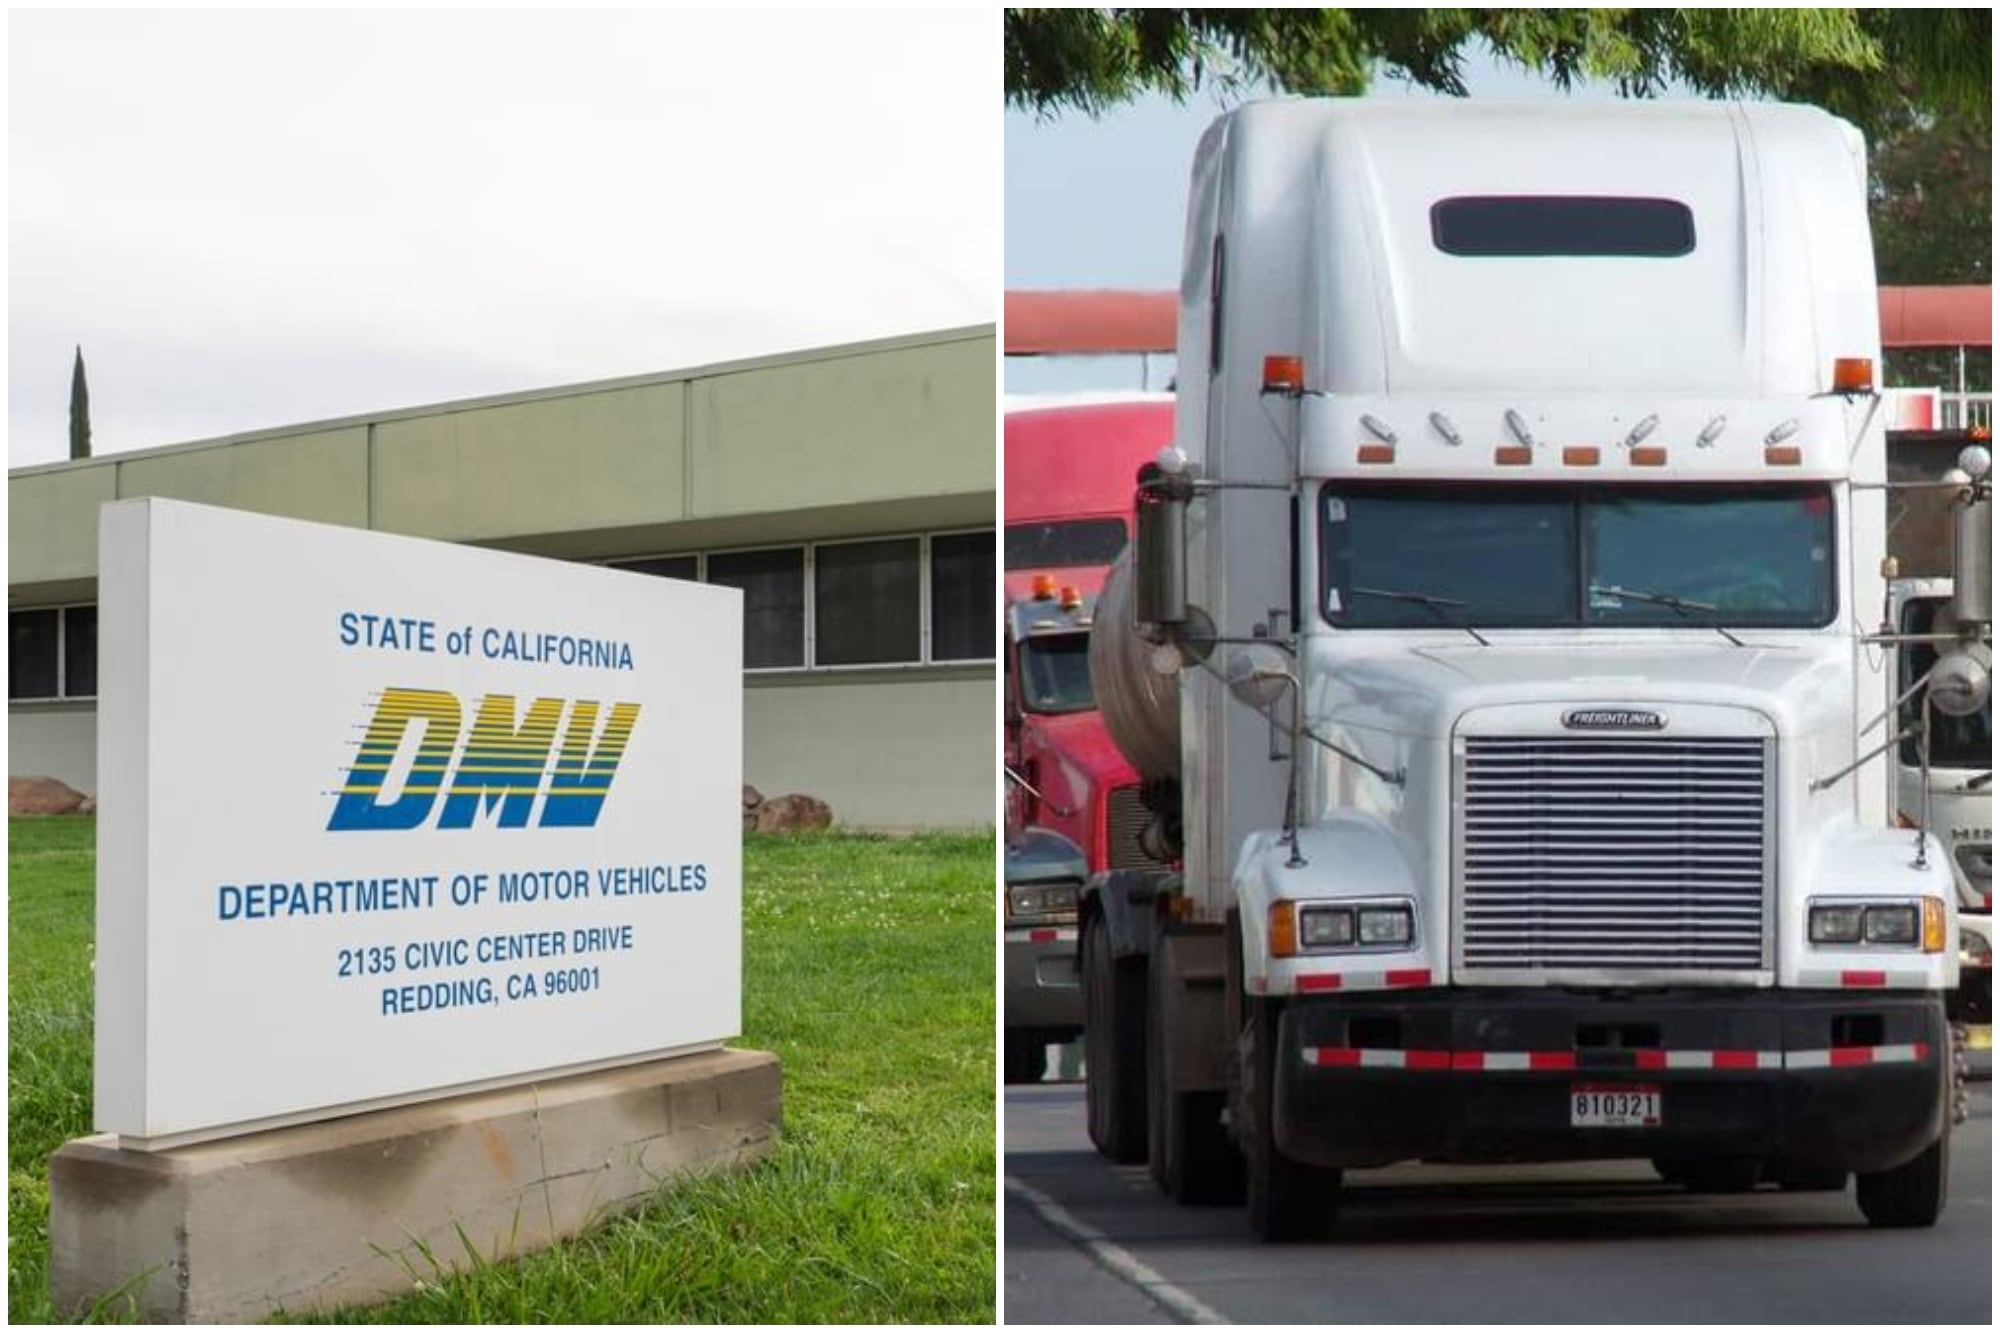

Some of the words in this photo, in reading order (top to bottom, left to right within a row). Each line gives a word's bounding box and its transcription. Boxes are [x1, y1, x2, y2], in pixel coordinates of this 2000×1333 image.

[340, 612, 435, 652] STATE
[446, 626, 473, 656] of
[482, 628, 633, 670] CALIFORNIA
[326, 687, 641, 831] DMV
[219, 876, 439, 920] DEPARTMENT
[452, 875, 488, 906] OF
[499, 870, 589, 902] MOTOR
[598, 864, 706, 896] VEHICLES
[338, 946, 396, 977] 2135
[405, 939, 468, 970] CIVIC
[477, 931, 565, 963] CENTER
[574, 925, 632, 953] DRIVE
[382, 978, 498, 1016] REDDING,
[507, 973, 537, 1000] CA
[545, 967, 599, 996] 96001
[1577, 1095, 1652, 1117] 810321
